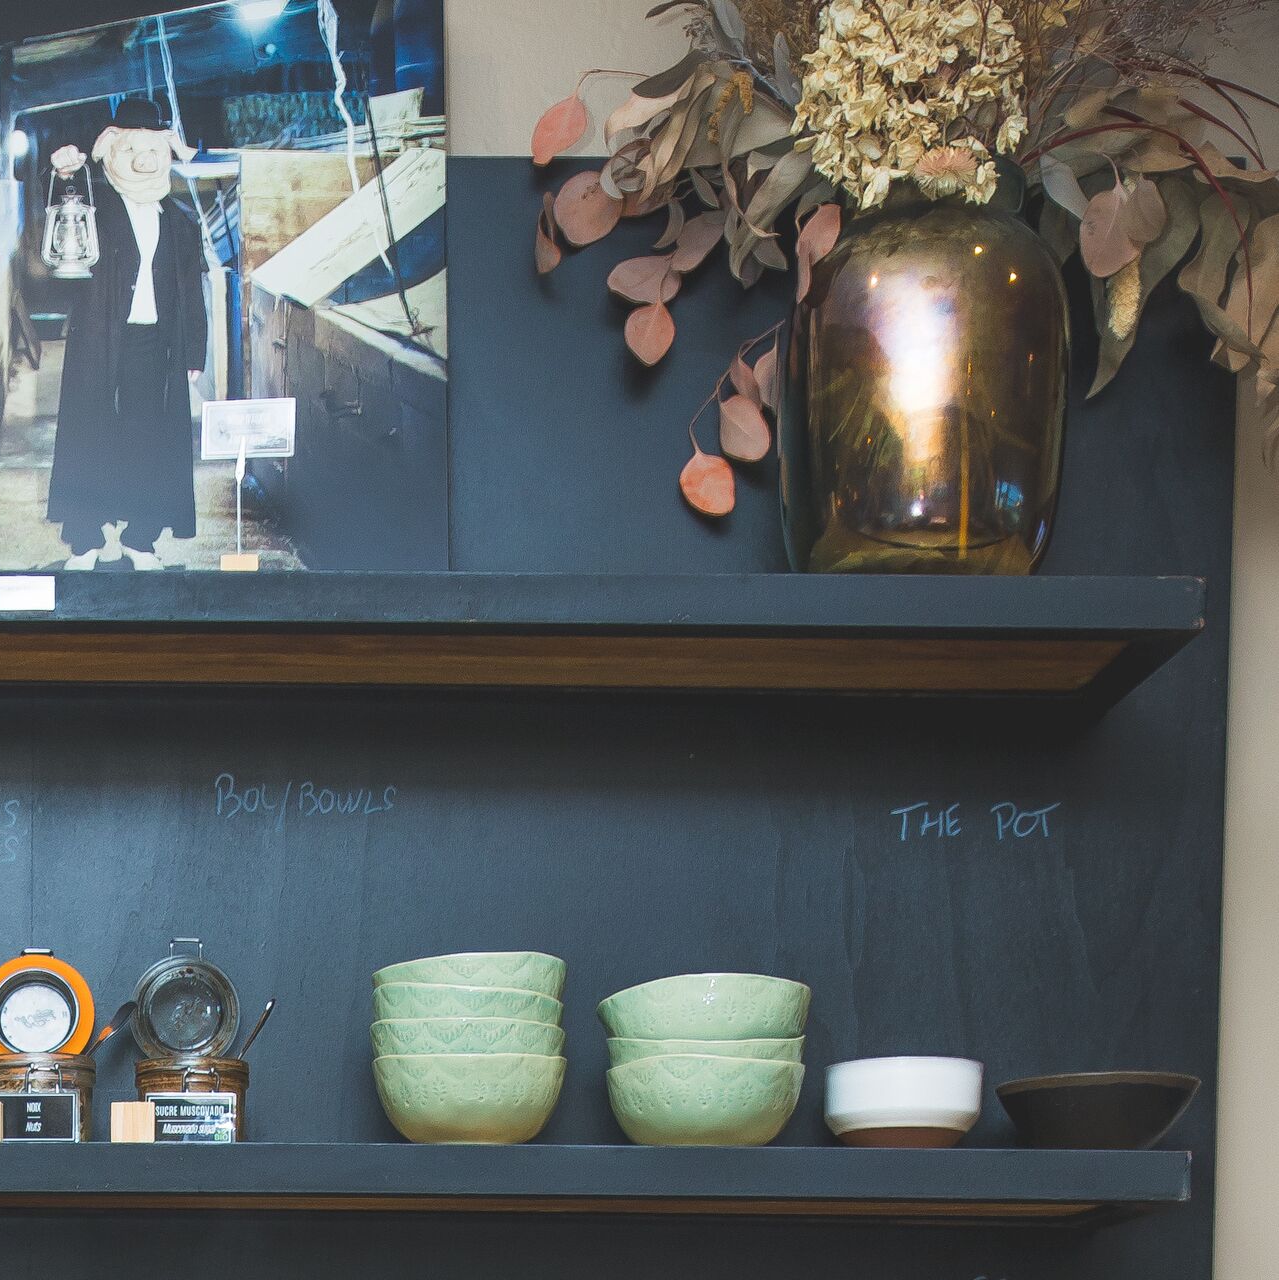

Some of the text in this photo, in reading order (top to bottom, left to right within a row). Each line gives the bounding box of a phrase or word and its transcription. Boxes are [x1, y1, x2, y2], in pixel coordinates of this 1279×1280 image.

[889, 802, 1063, 841] THE POT
[26, 1102, 41, 1112] NOIX
[155, 1105, 224, 1117] SUCRE MUSCOVADO
[25, 1121, 42, 1132] Nuts
[162, 1123, 198, 1134] Muscovado
